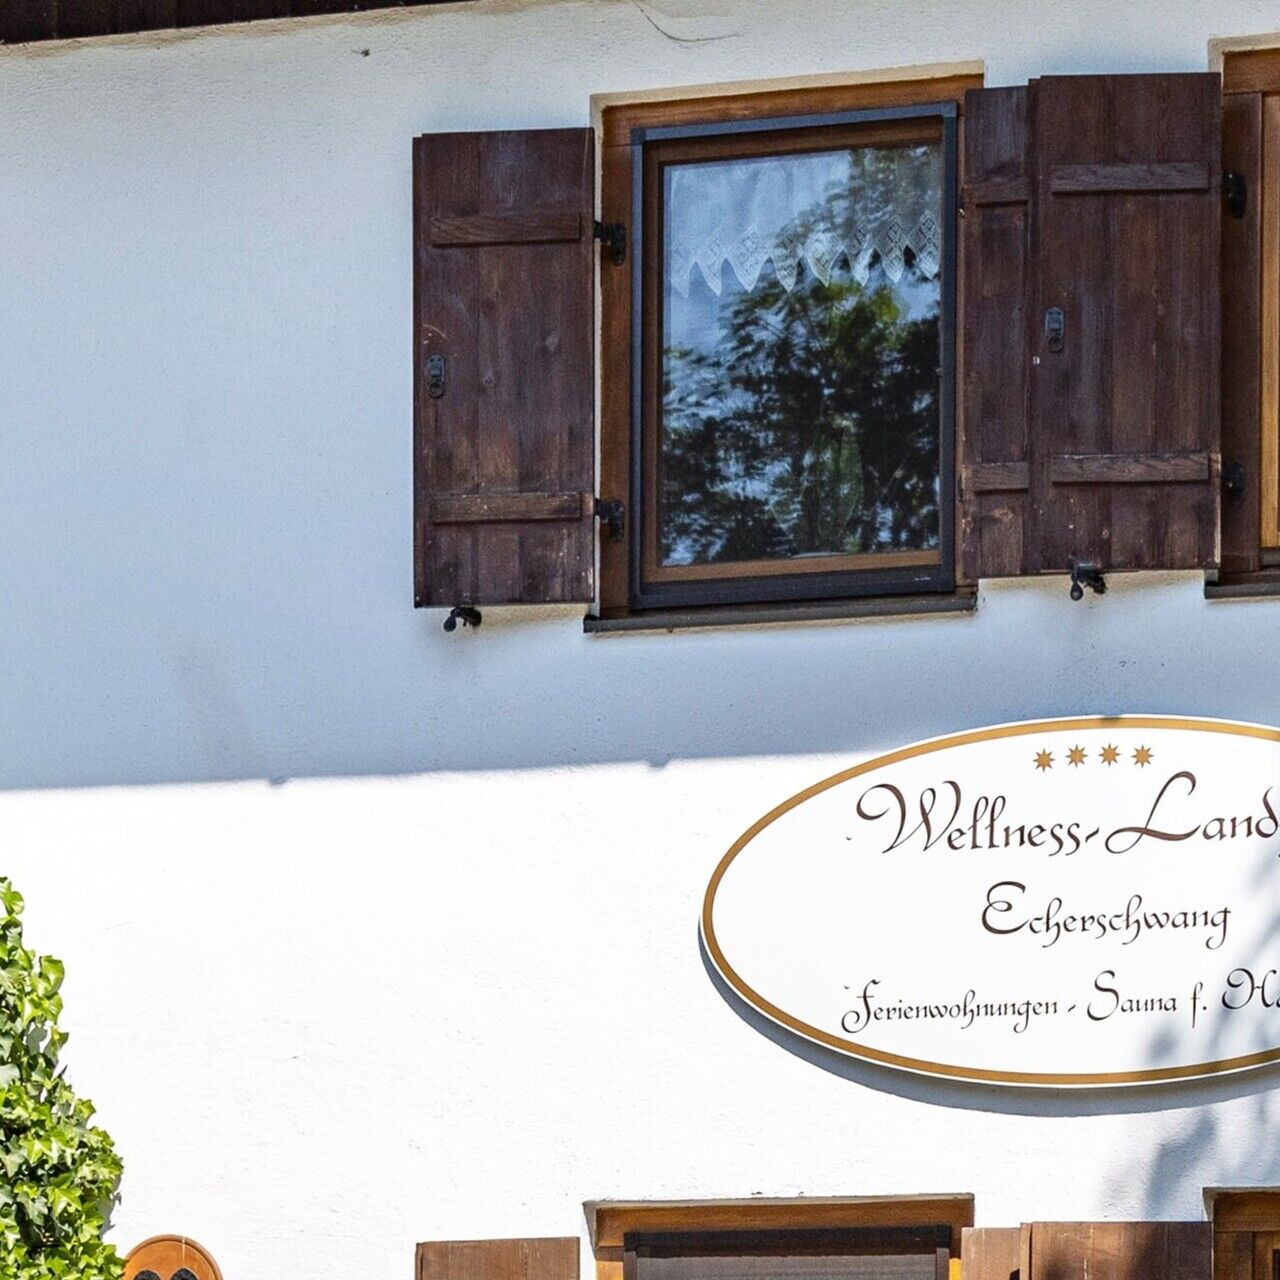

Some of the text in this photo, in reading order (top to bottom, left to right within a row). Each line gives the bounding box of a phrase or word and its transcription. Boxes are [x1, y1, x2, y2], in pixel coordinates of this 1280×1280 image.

[981, 880, 1231, 950] Echerschwang
[841, 978, 1058, 1034] Ferienwohnungen
[1087, 969, 1177, 1021] Sauna
[1190, 981, 1207, 1029] f.
